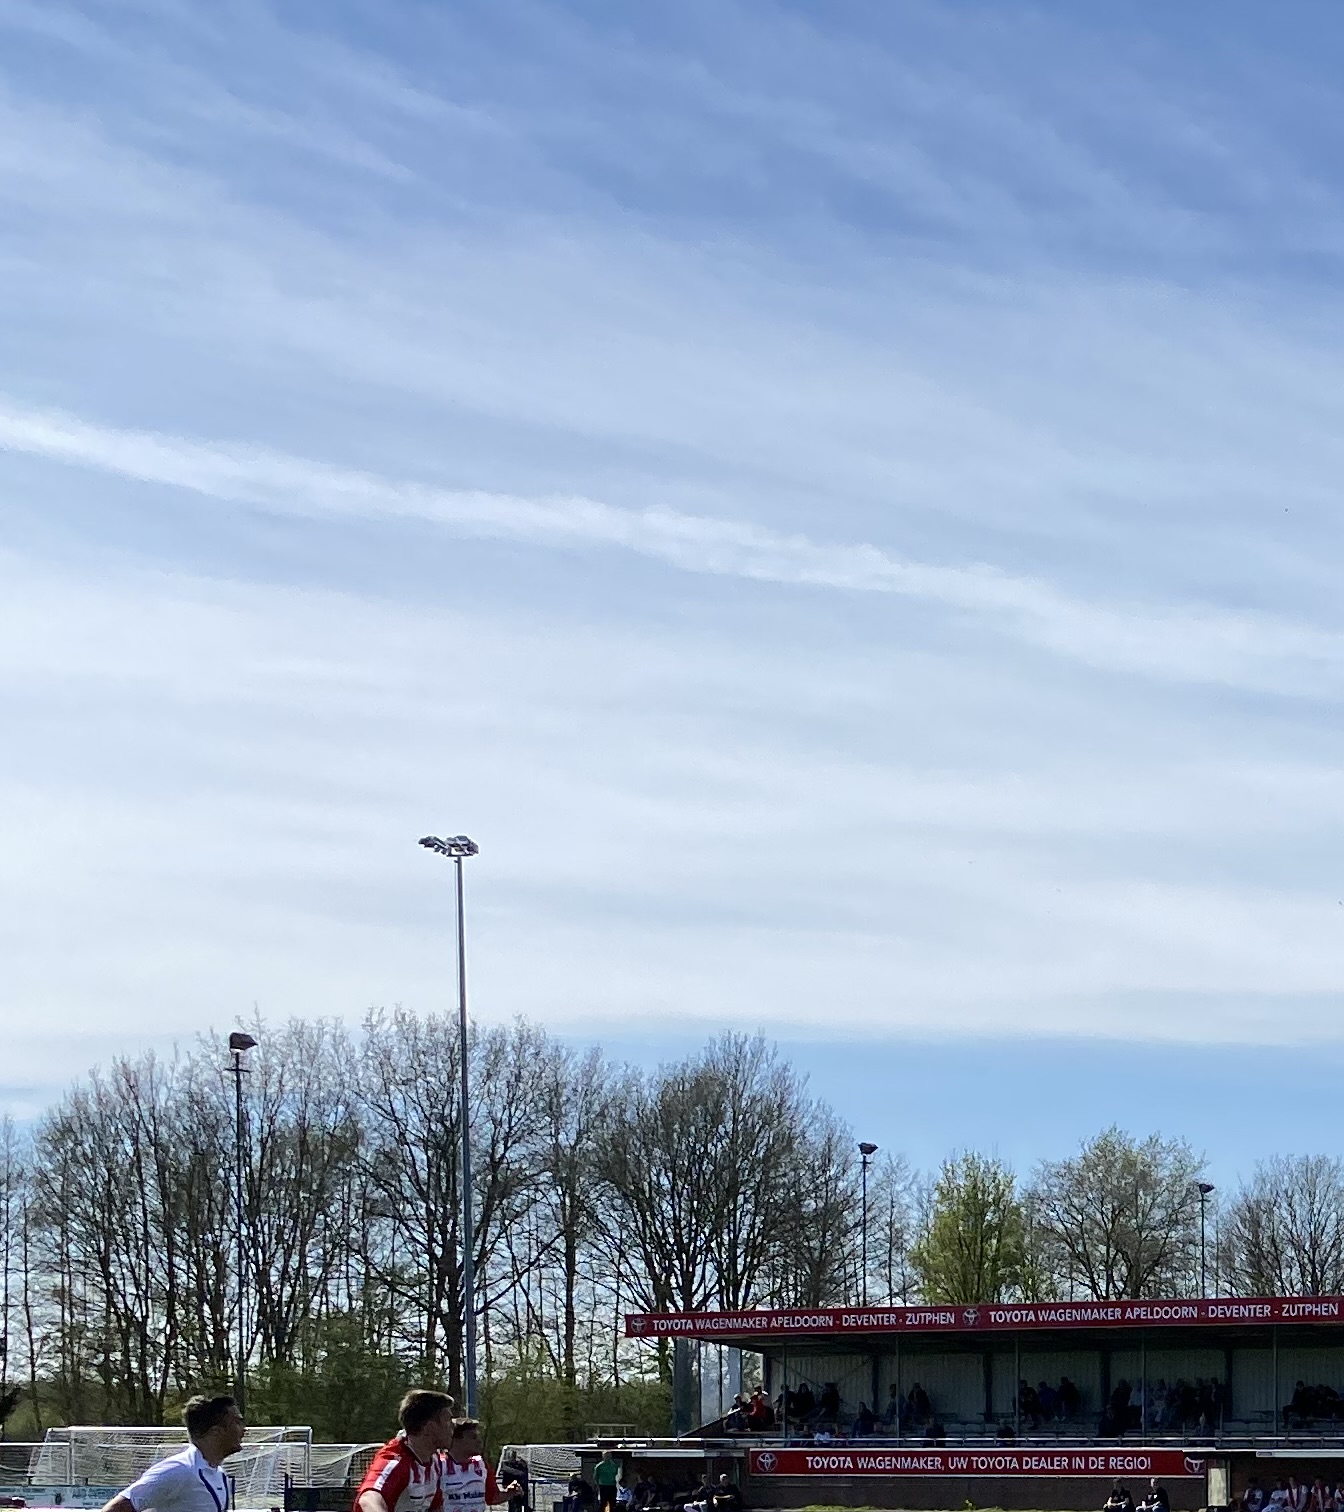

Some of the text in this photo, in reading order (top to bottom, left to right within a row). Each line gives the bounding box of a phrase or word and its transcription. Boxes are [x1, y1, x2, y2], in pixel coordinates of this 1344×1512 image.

[652, 1318, 694, 1331] TOYOTA
[695, 1315, 768, 1330] WAGENMAKER
[769, 1313, 834, 1328] APELDOORN
[842, 1312, 897, 1327] DEVENTER
[905, 1311, 955, 1325] ZUTPHEN
[989, 1310, 1036, 1323] TOYOTA
[1037, 1307, 1122, 1322] WAGENMAKER
[1124, 1305, 1198, 1320] APELDOORN
[1208, 1304, 1271, 1319] DEVENTER
[1281, 1302, 1339, 1317] ZUTPHEN
[806, 1456, 853, 1470] TOYOTA
[856, 1456, 945, 1471] WAGENMAKER,
[948, 1456, 969, 1470] UW
[971, 1456, 1019, 1470] TOYOTA
[1022, 1456, 1069, 1470] DEALER
[1072, 1456, 1085, 1470] IN
[1088, 1456, 1105, 1470] DE
